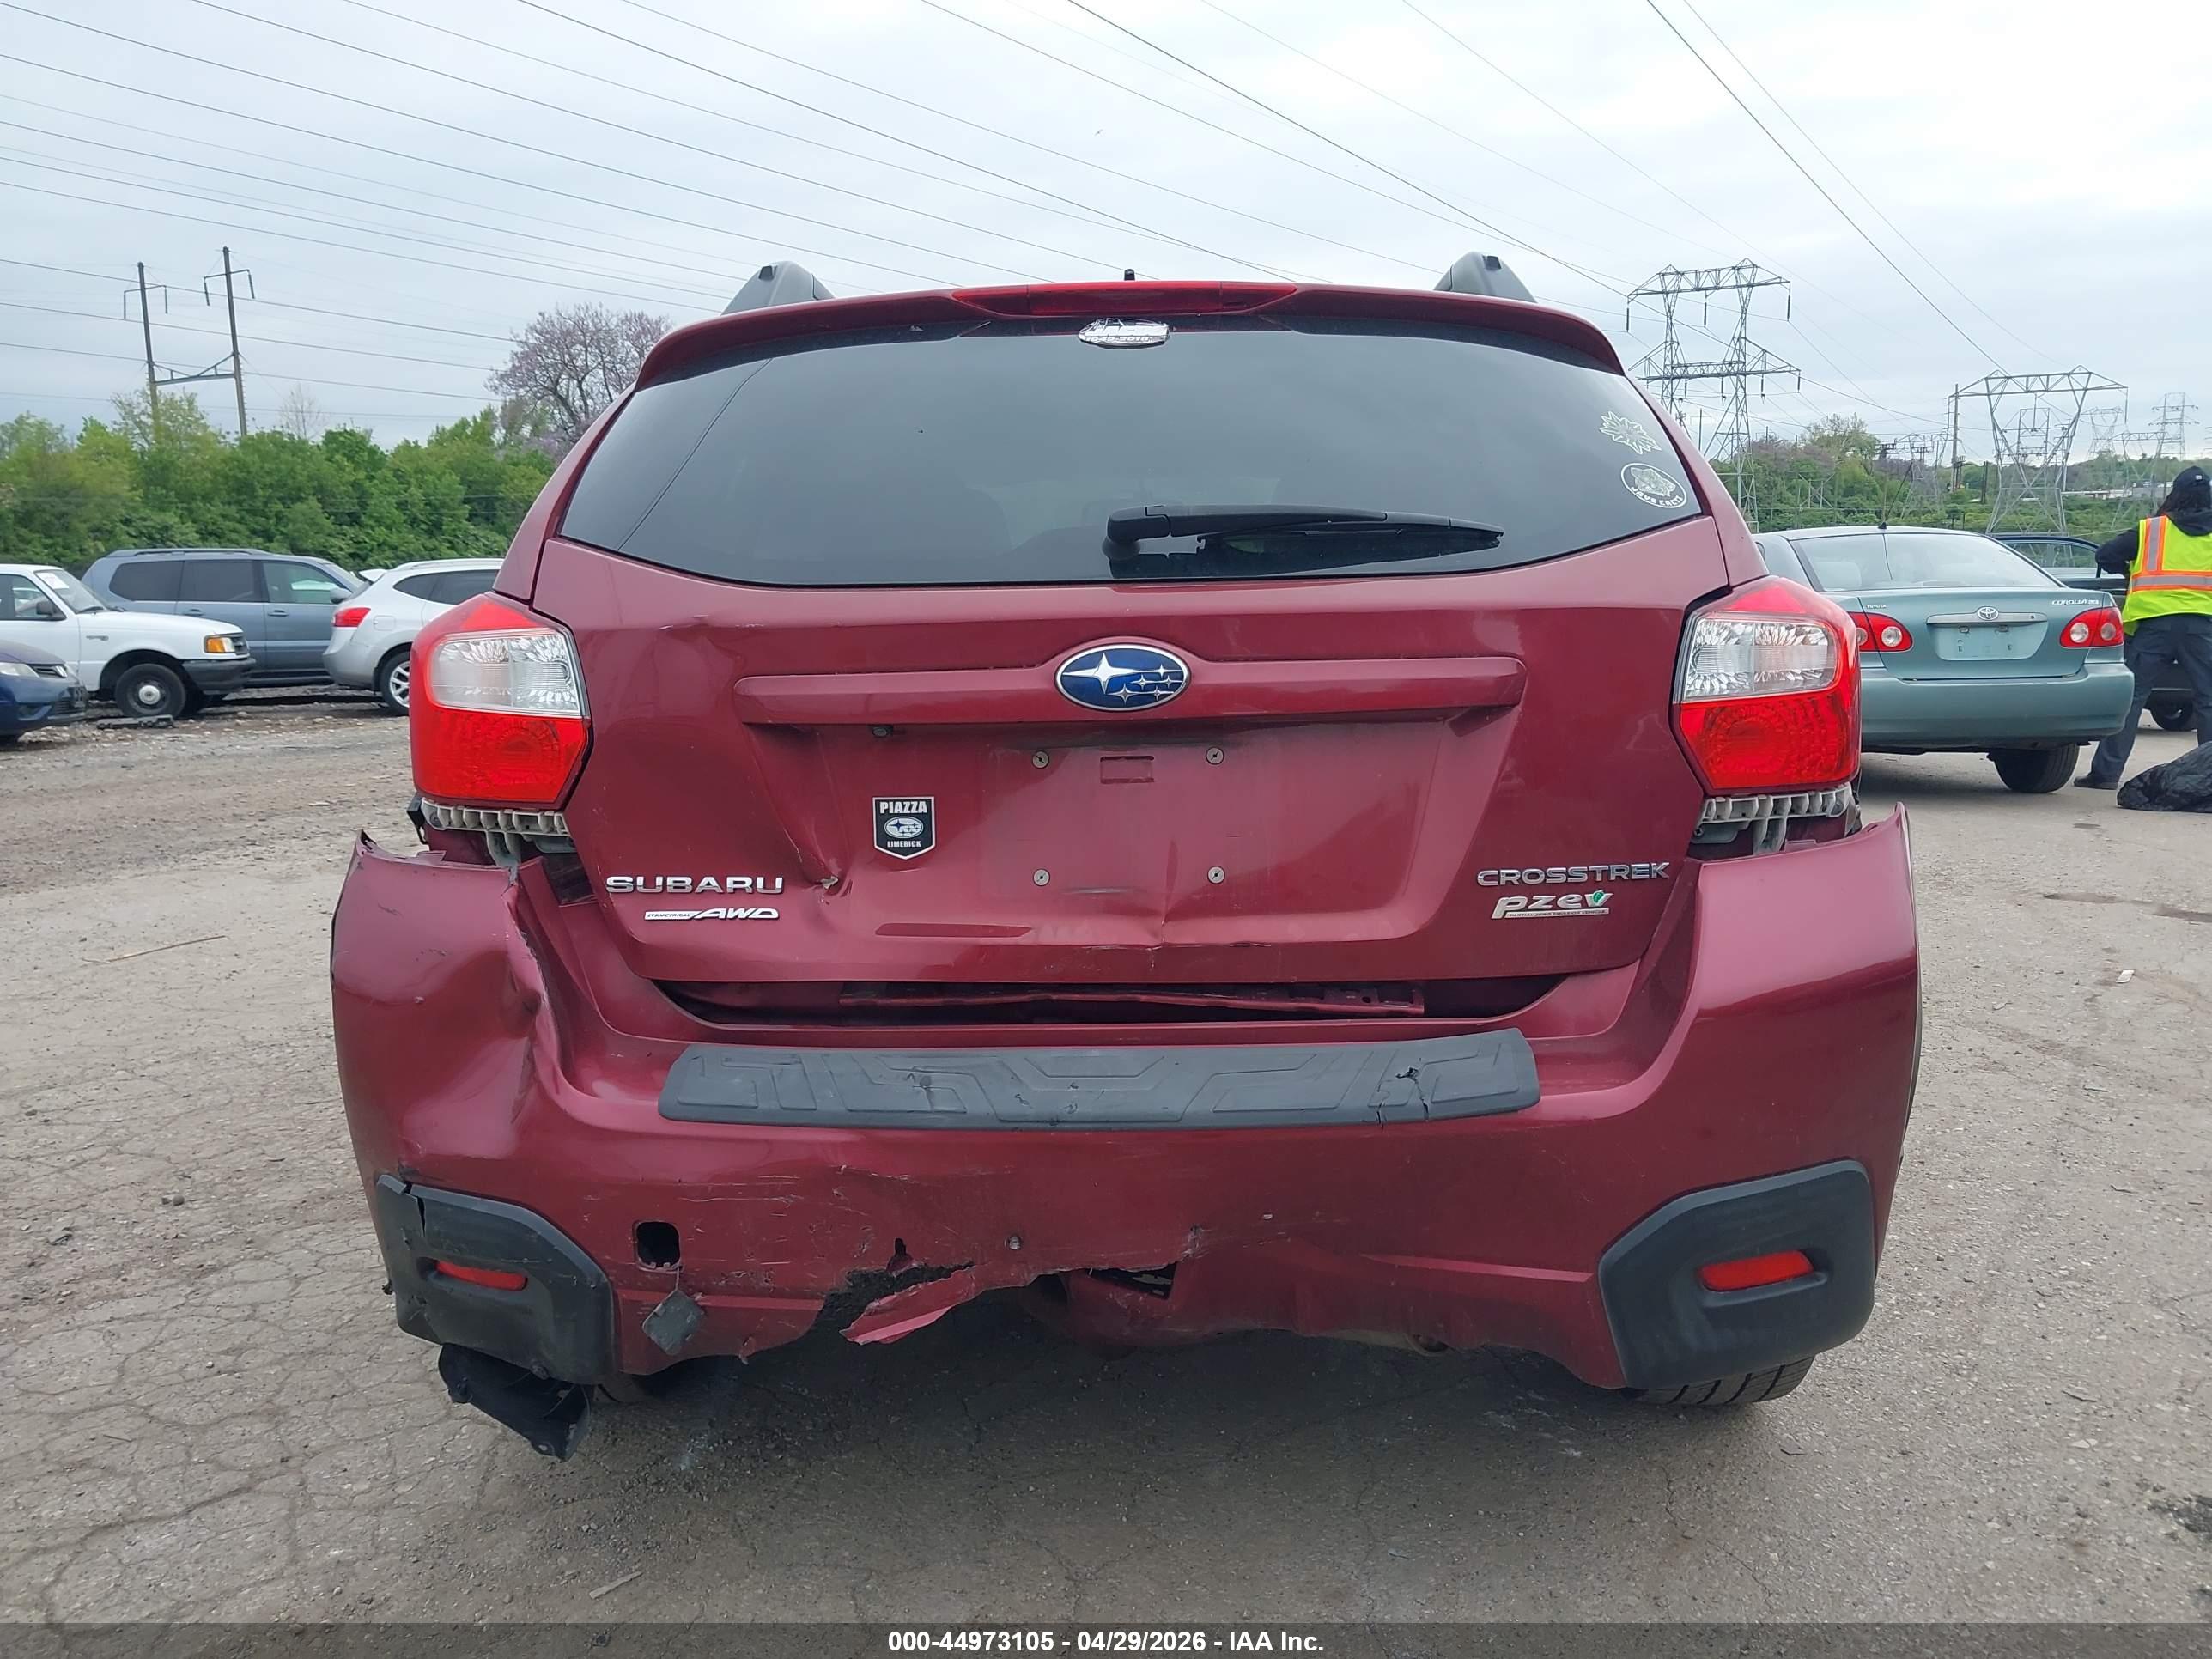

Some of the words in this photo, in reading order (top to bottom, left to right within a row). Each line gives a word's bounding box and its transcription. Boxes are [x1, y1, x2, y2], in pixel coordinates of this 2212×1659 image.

[879, 801, 927, 814] PIAZZA
[1477, 862, 1670, 886] CROSSTREK
[606, 876, 783, 894] SUBARU
[694, 908, 779, 920] AWD
